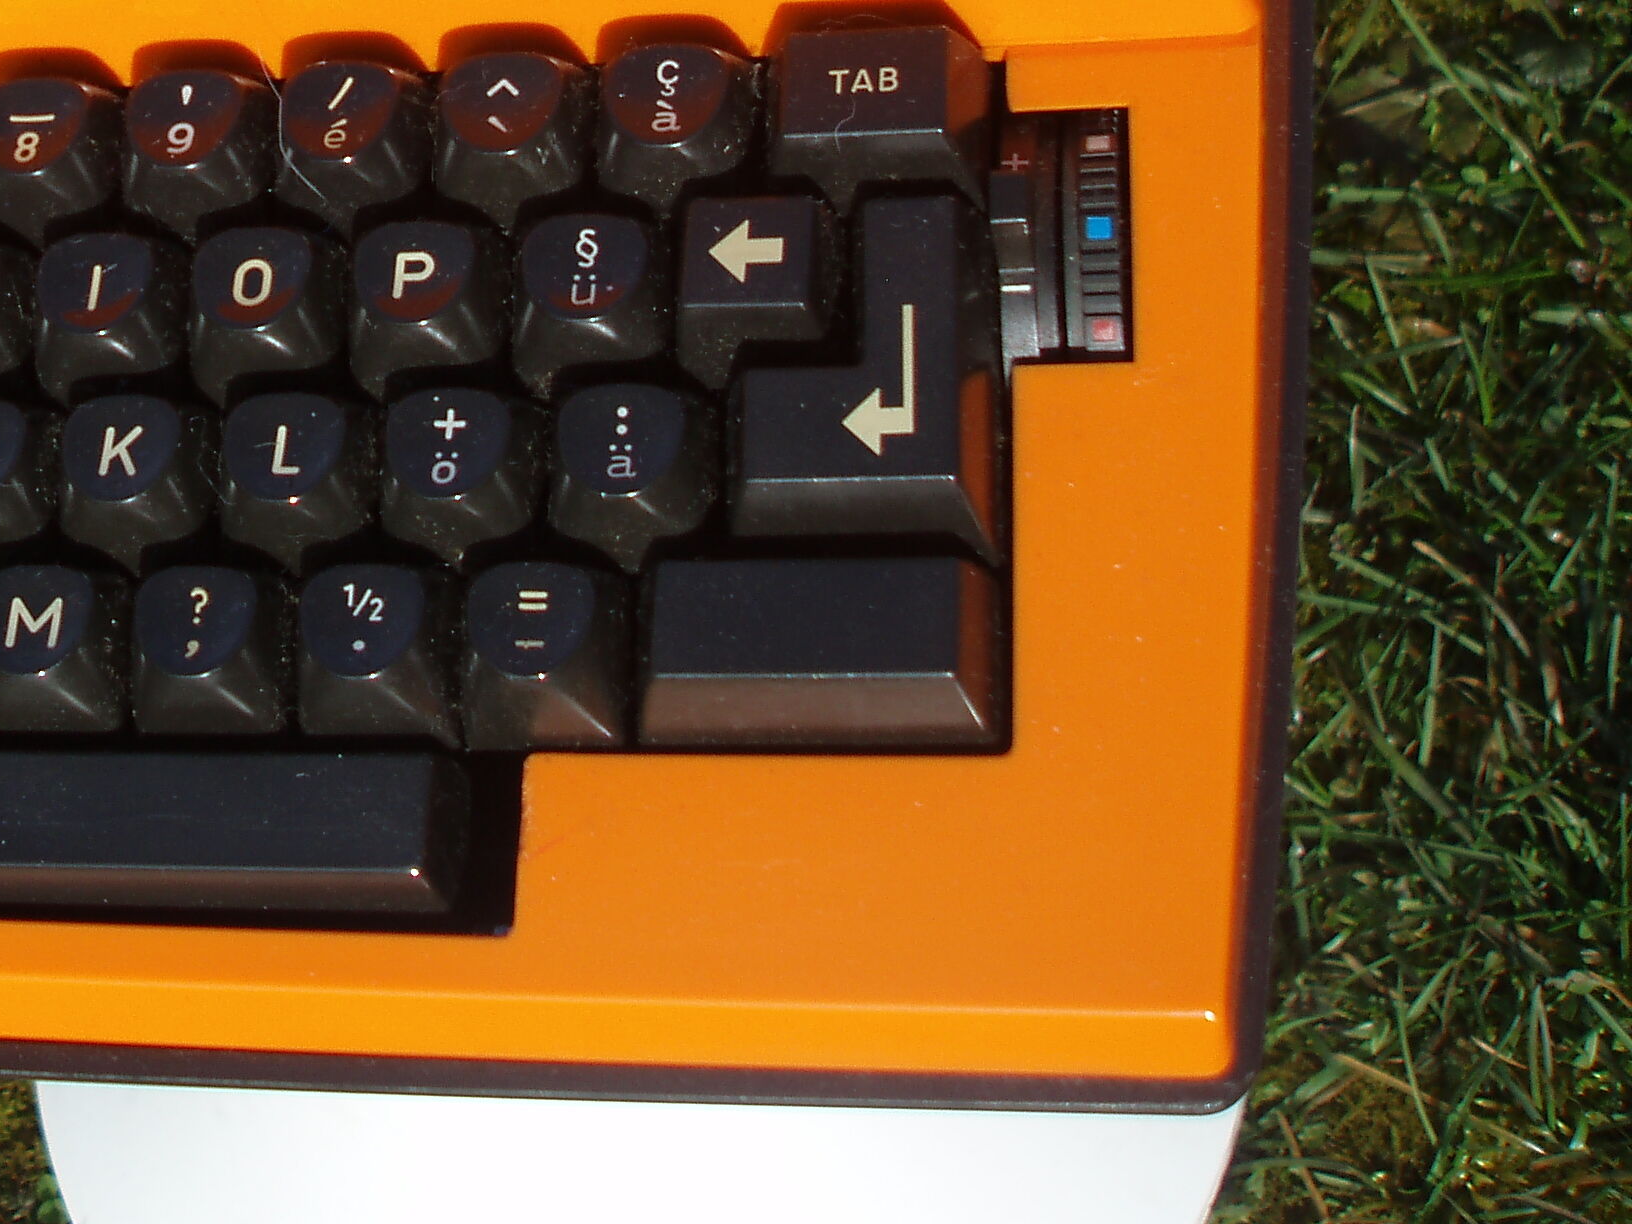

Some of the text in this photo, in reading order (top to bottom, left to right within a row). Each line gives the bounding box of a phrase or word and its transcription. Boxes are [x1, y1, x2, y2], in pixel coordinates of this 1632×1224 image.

[828, 67, 899, 94] TAB
[14, 131, 40, 162] 8
[167, 122, 195, 154] 9
[575, 228, 598, 268] §
[87, 264, 102, 311] I
[232, 259, 273, 306] O
[392, 251, 435, 299] P
[98, 425, 143, 476] K
[271, 425, 300, 475] L
[5, 597, 63, 648] M
[190, 587, 208, 624] ?
